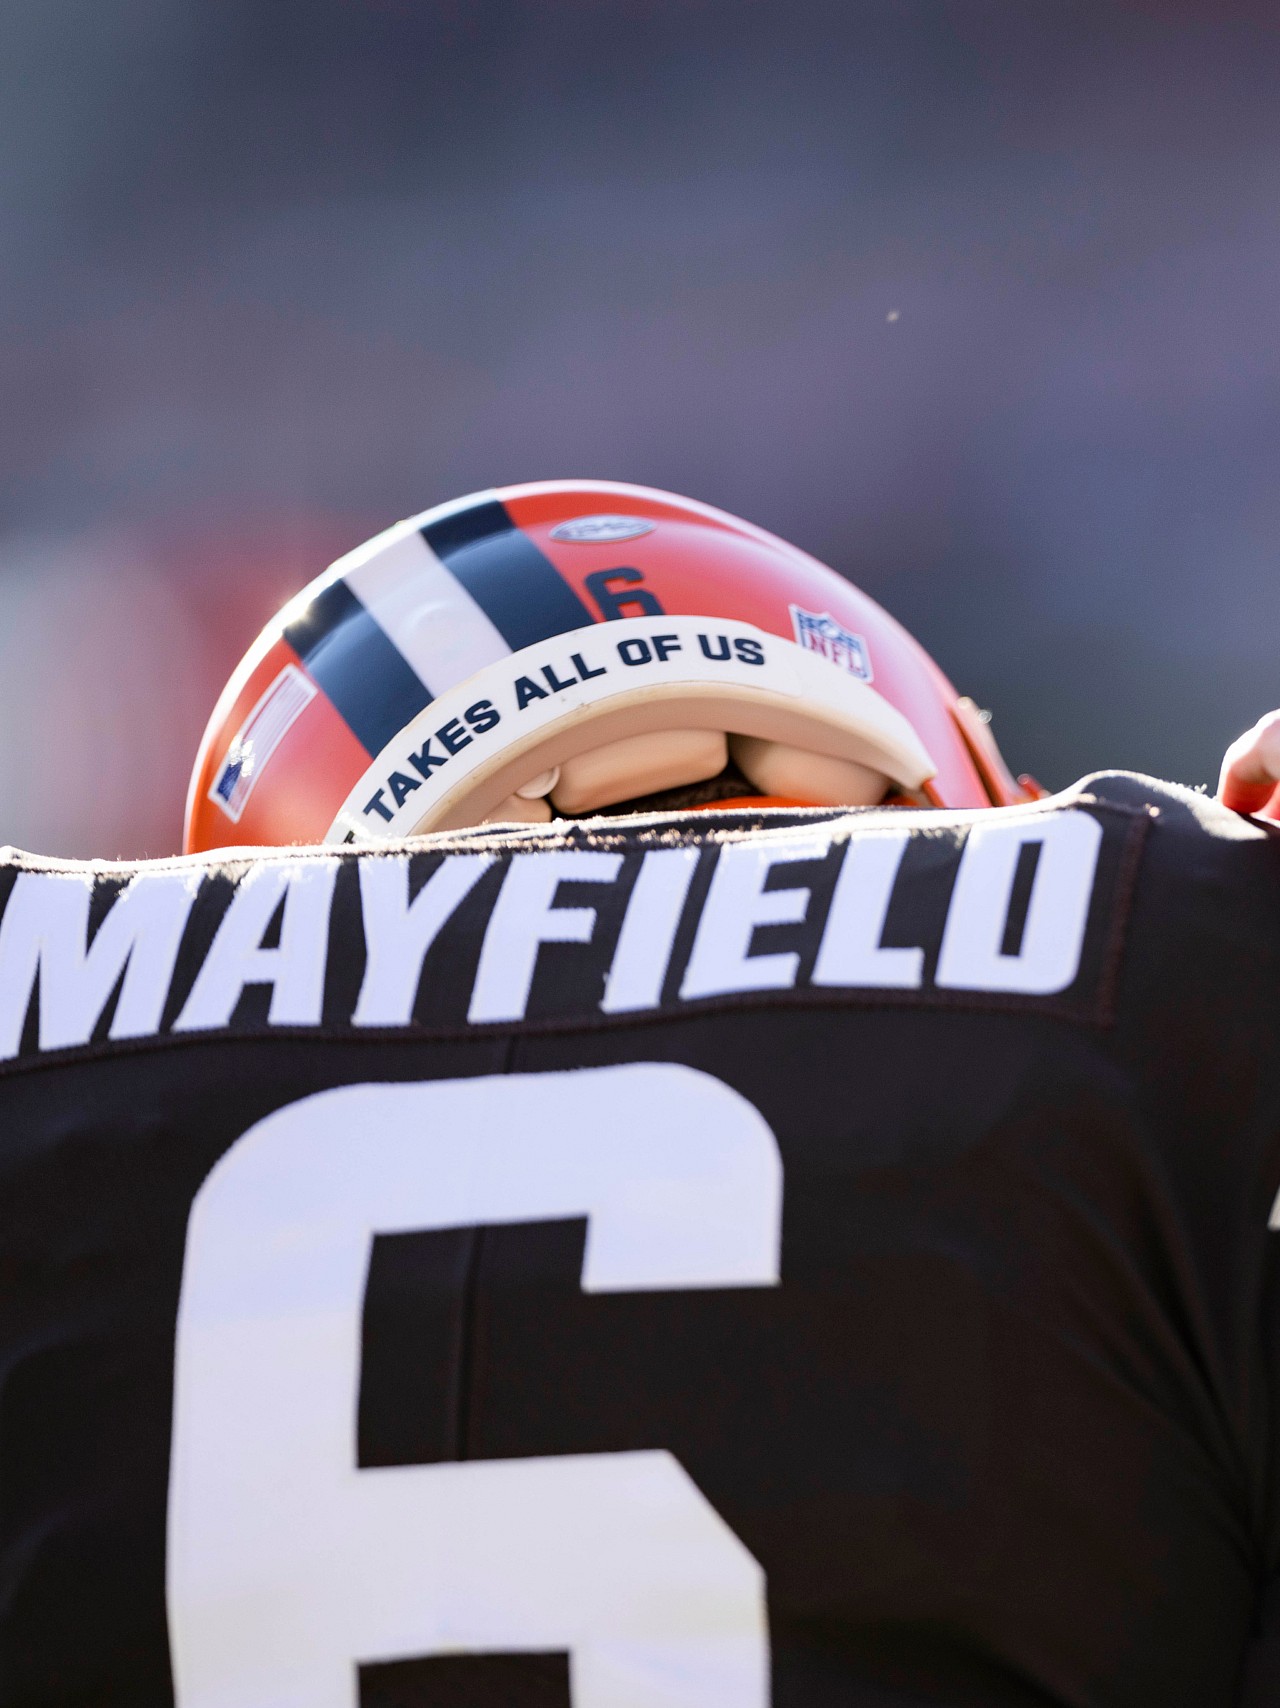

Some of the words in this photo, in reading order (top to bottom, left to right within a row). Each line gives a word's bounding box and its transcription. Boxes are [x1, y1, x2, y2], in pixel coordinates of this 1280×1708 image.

[584, 567, 667, 621] 6
[807, 628, 866, 673] NFL
[363, 699, 501, 823] TAKES
[514, 652, 607, 711] ALL
[616, 634, 682, 666] OF
[697, 634, 765, 666] US
[0, 809, 1103, 1061] MAYFIELD
[166, 1061, 783, 1708] 6
